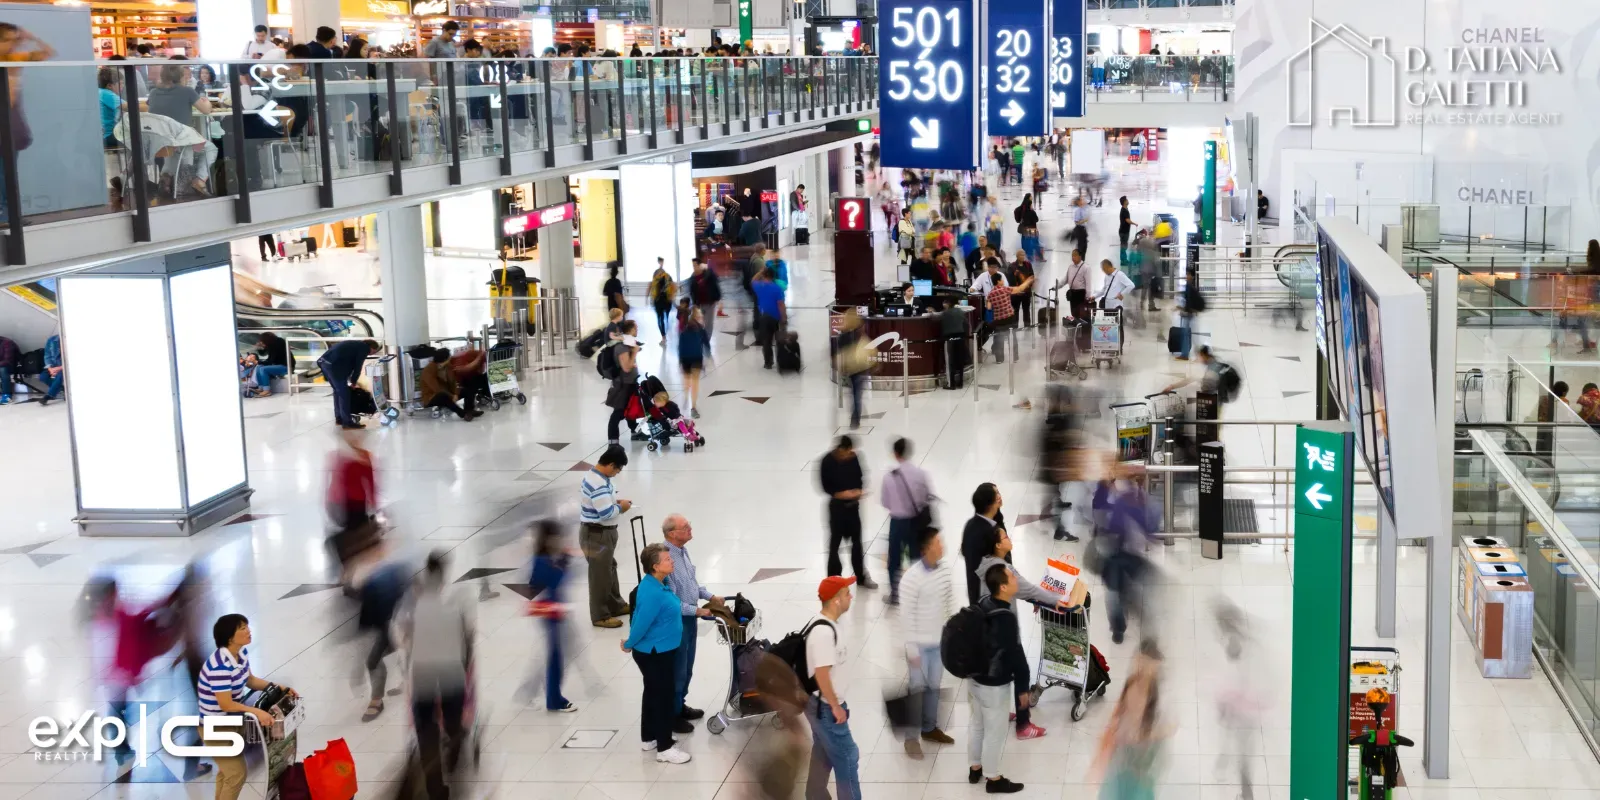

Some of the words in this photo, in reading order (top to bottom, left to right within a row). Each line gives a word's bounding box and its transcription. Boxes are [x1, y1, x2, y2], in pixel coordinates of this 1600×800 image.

[891, 6, 960, 48] 501
[1461, 27, 1545, 44] CHANEL
[995, 29, 1031, 57] 20
[888, 59, 964, 102] 530
[995, 64, 1031, 92] 32
[761, 193, 777, 201] SALE
[1457, 186, 1535, 205] CHANEL
